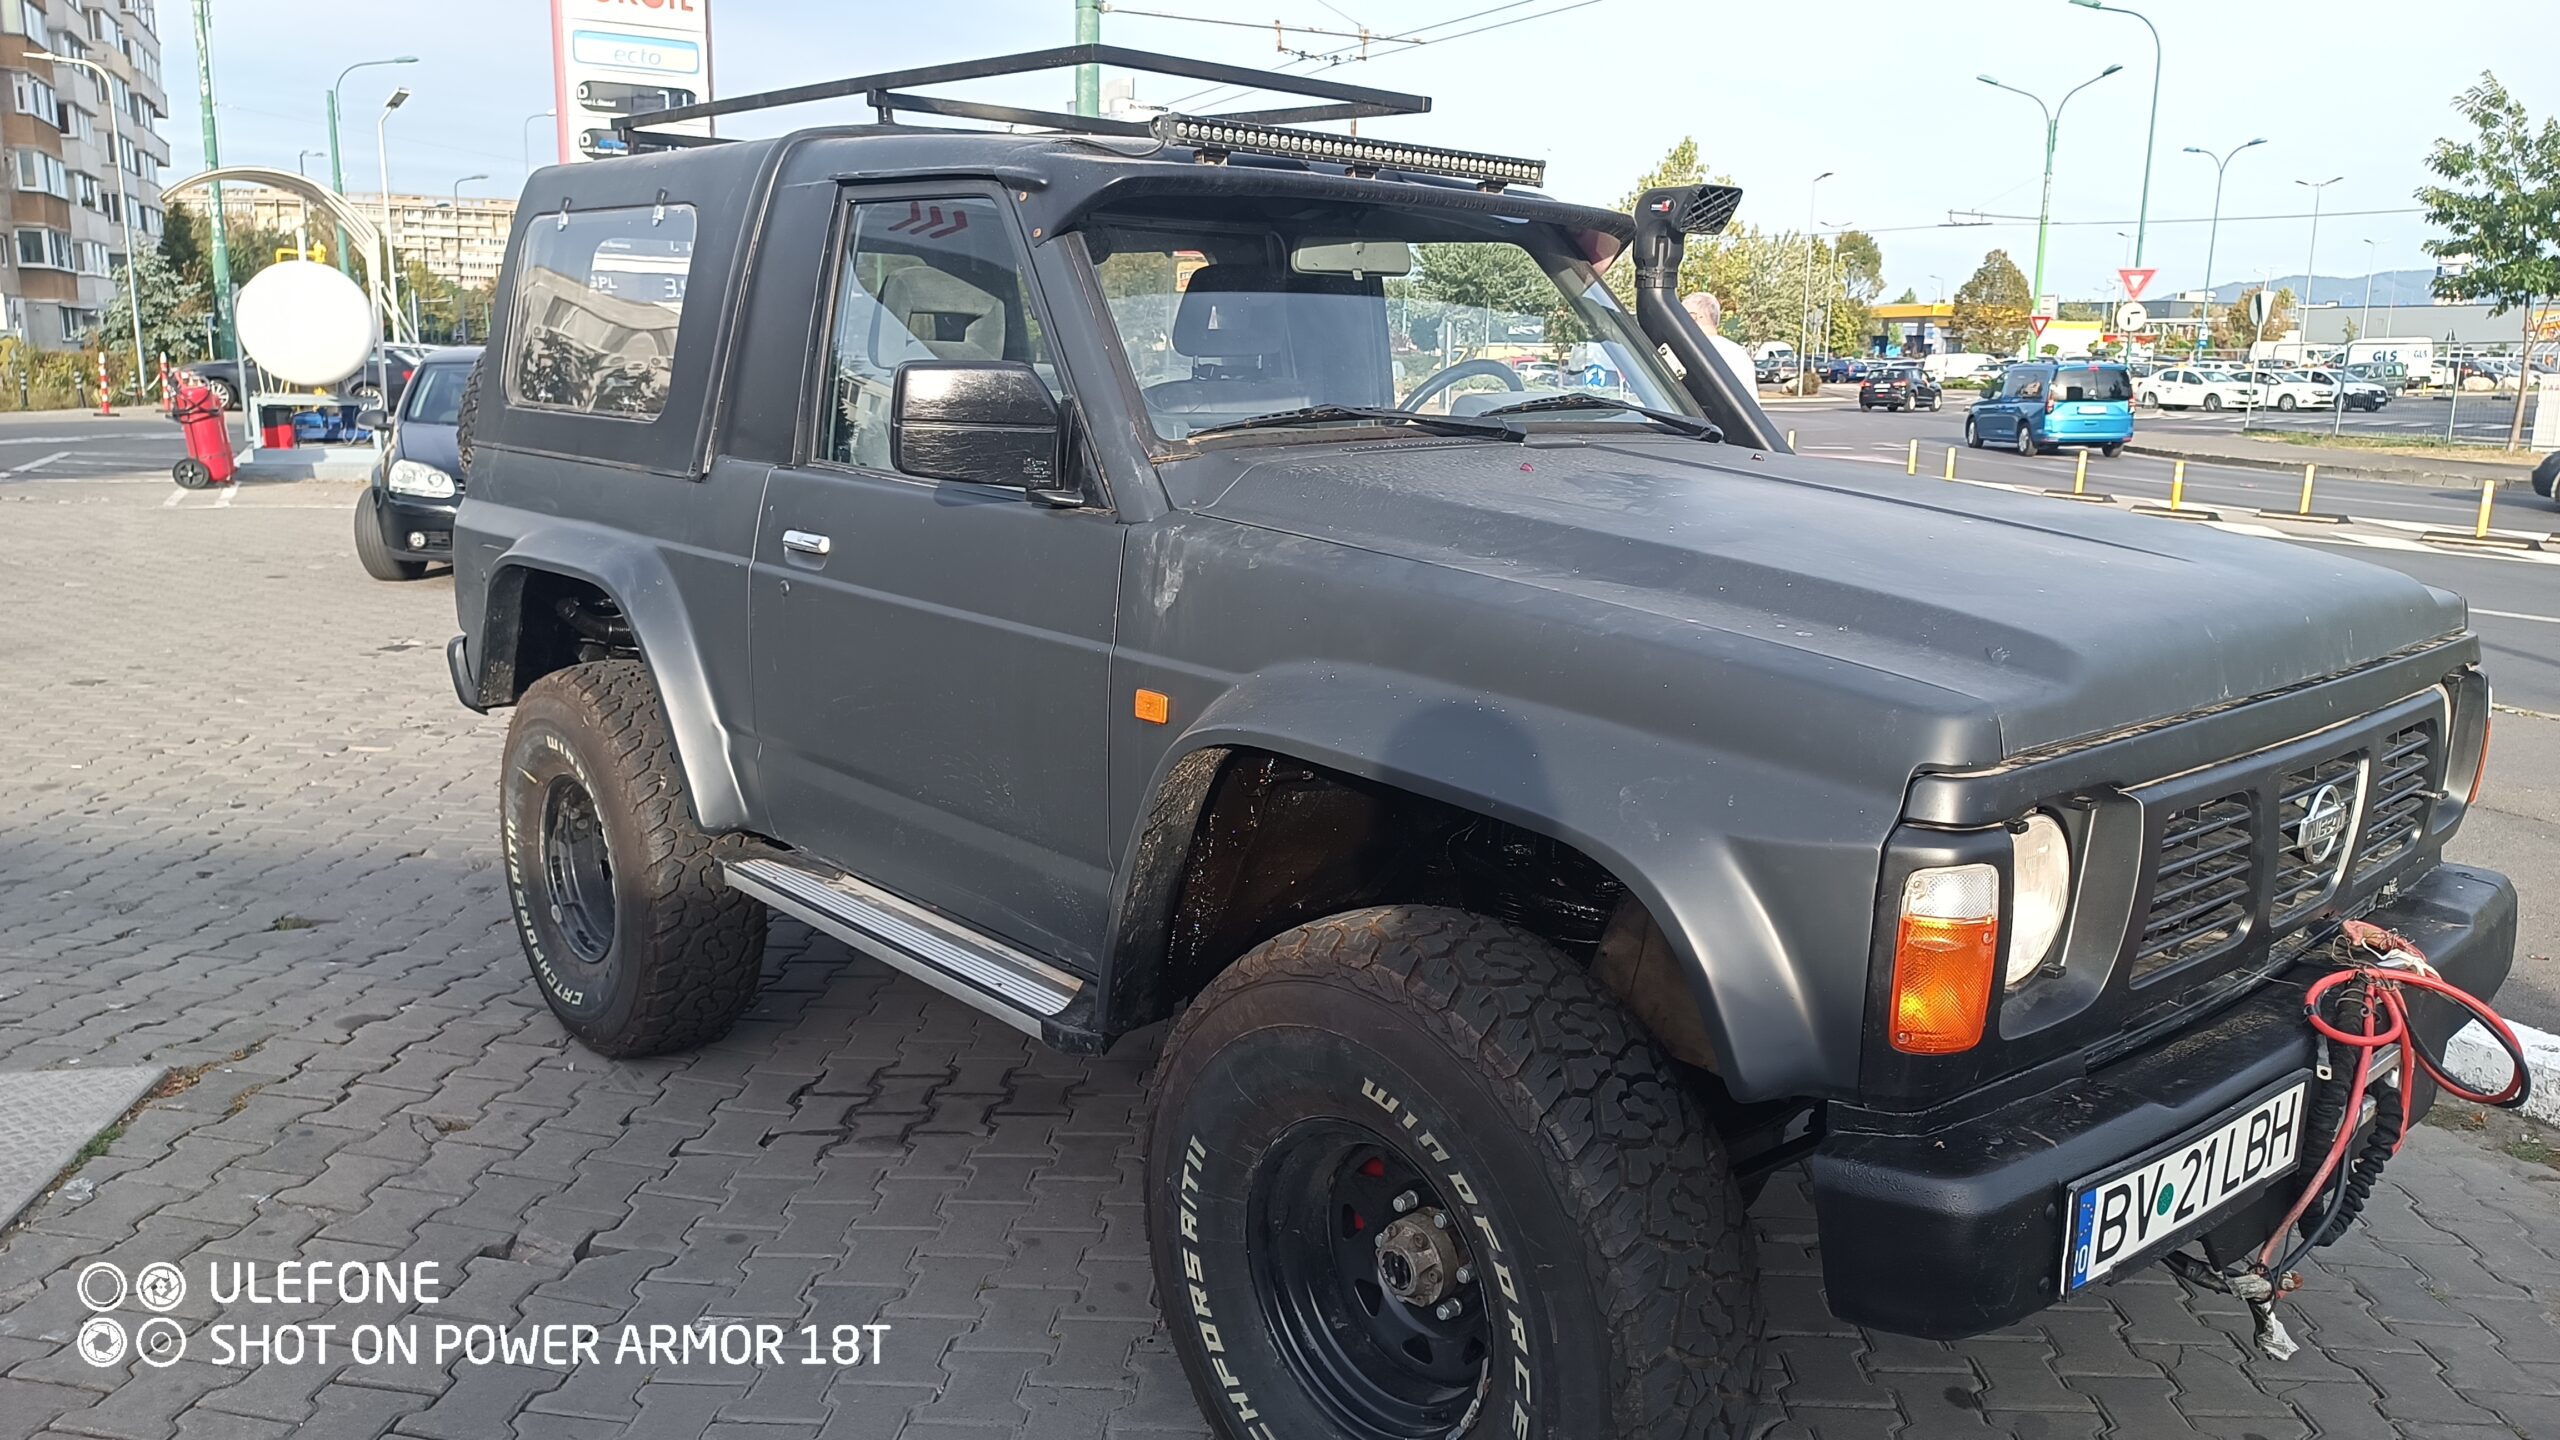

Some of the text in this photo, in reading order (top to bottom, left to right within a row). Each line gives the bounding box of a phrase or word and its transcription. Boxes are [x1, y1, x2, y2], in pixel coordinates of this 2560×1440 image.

[614, 48, 662, 66] ecto
[2372, 350, 2398, 362] GLS
[2413, 350, 2428, 358] GLS
[2094, 1164, 2165, 1266] BV
[1360, 1077, 1531, 1440] WINDFORCE
